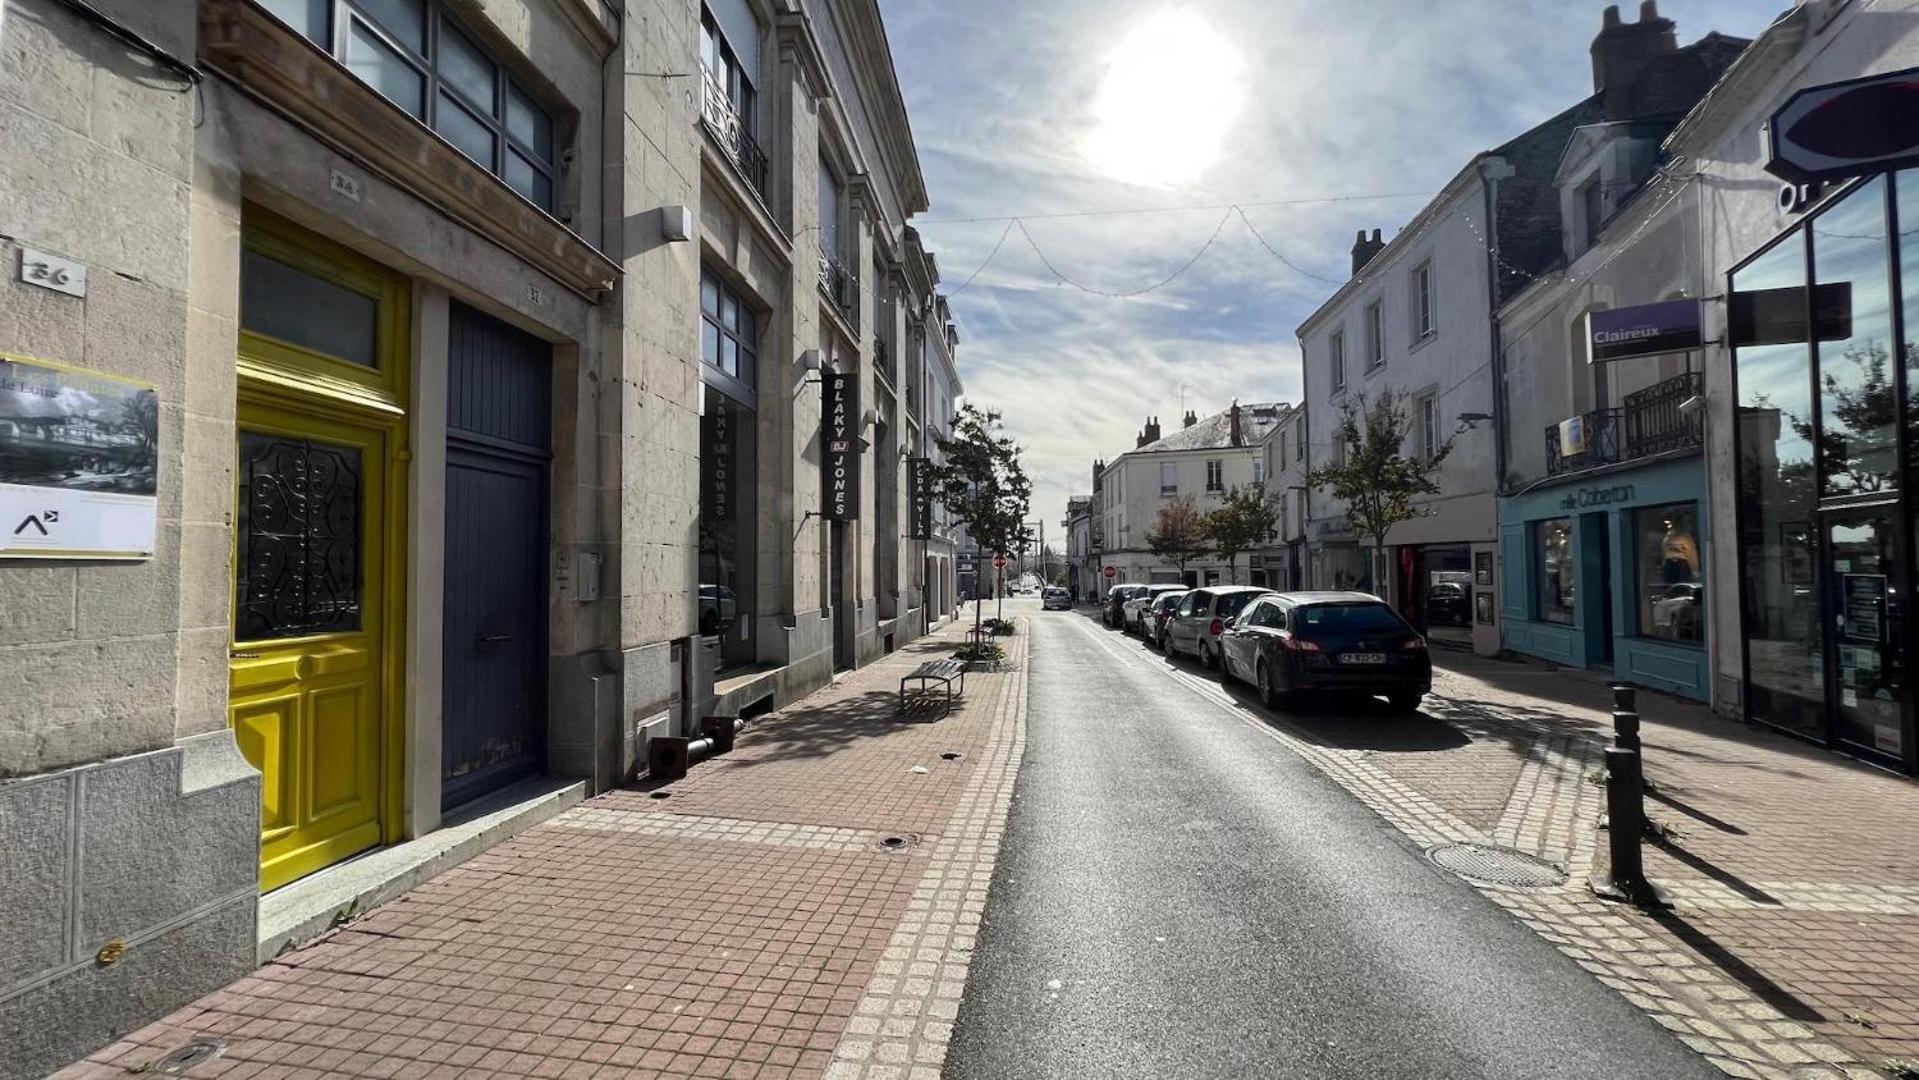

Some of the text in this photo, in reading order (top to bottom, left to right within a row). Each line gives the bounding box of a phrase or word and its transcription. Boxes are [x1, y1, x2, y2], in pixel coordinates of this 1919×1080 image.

[1594, 327, 1660, 344] Claireux
[833, 378, 846, 438] BLAKY
[833, 454, 846, 516] JONES
